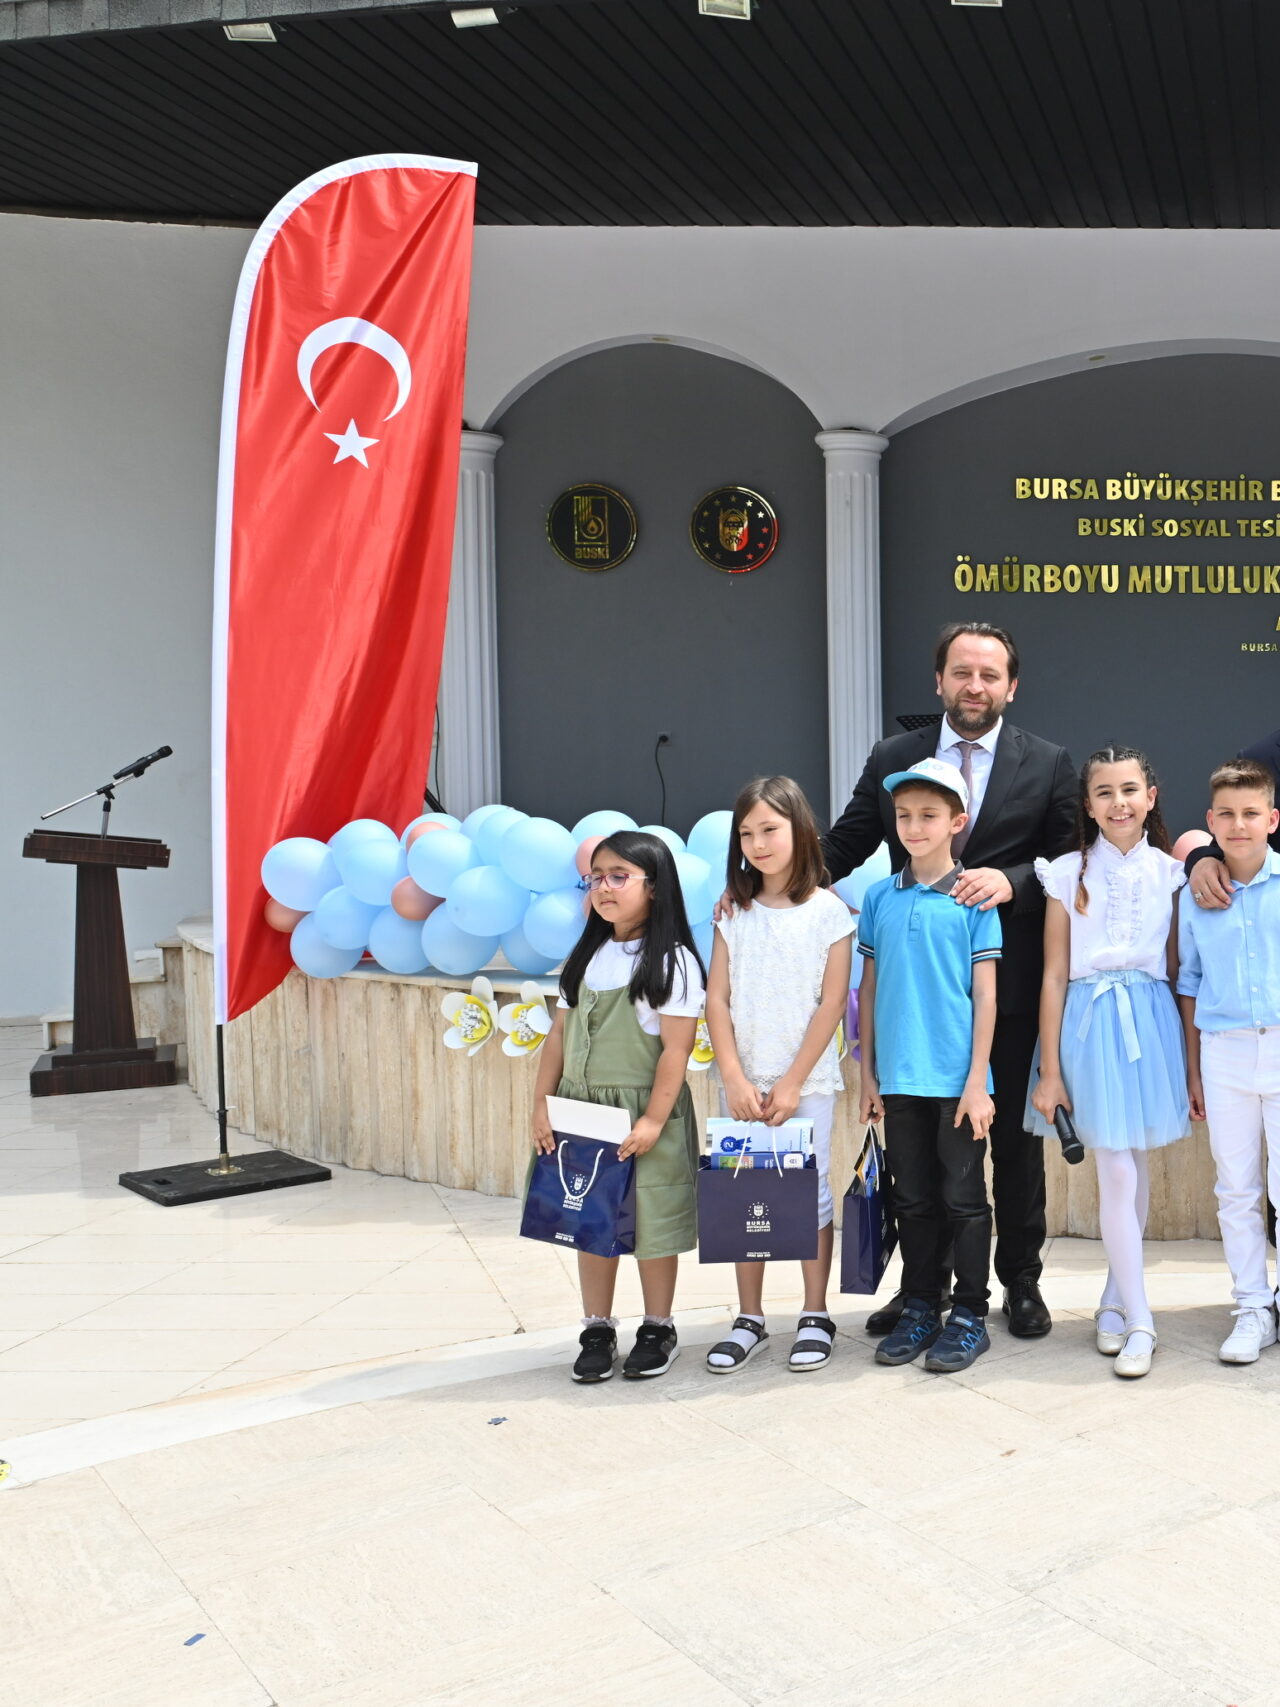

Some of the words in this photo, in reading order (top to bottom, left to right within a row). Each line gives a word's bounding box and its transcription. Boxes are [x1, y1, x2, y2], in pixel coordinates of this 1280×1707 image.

[1015, 477, 1100, 500] BURSA
[1106, 471, 1264, 506] BÜYÜKŞEHİR
[1077, 513, 1145, 537] BUSKİ
[1151, 519, 1232, 537] SOSYAL
[953, 555, 1120, 594] ÖMÜRBOYU
[1241, 642, 1278, 652] BURSA
